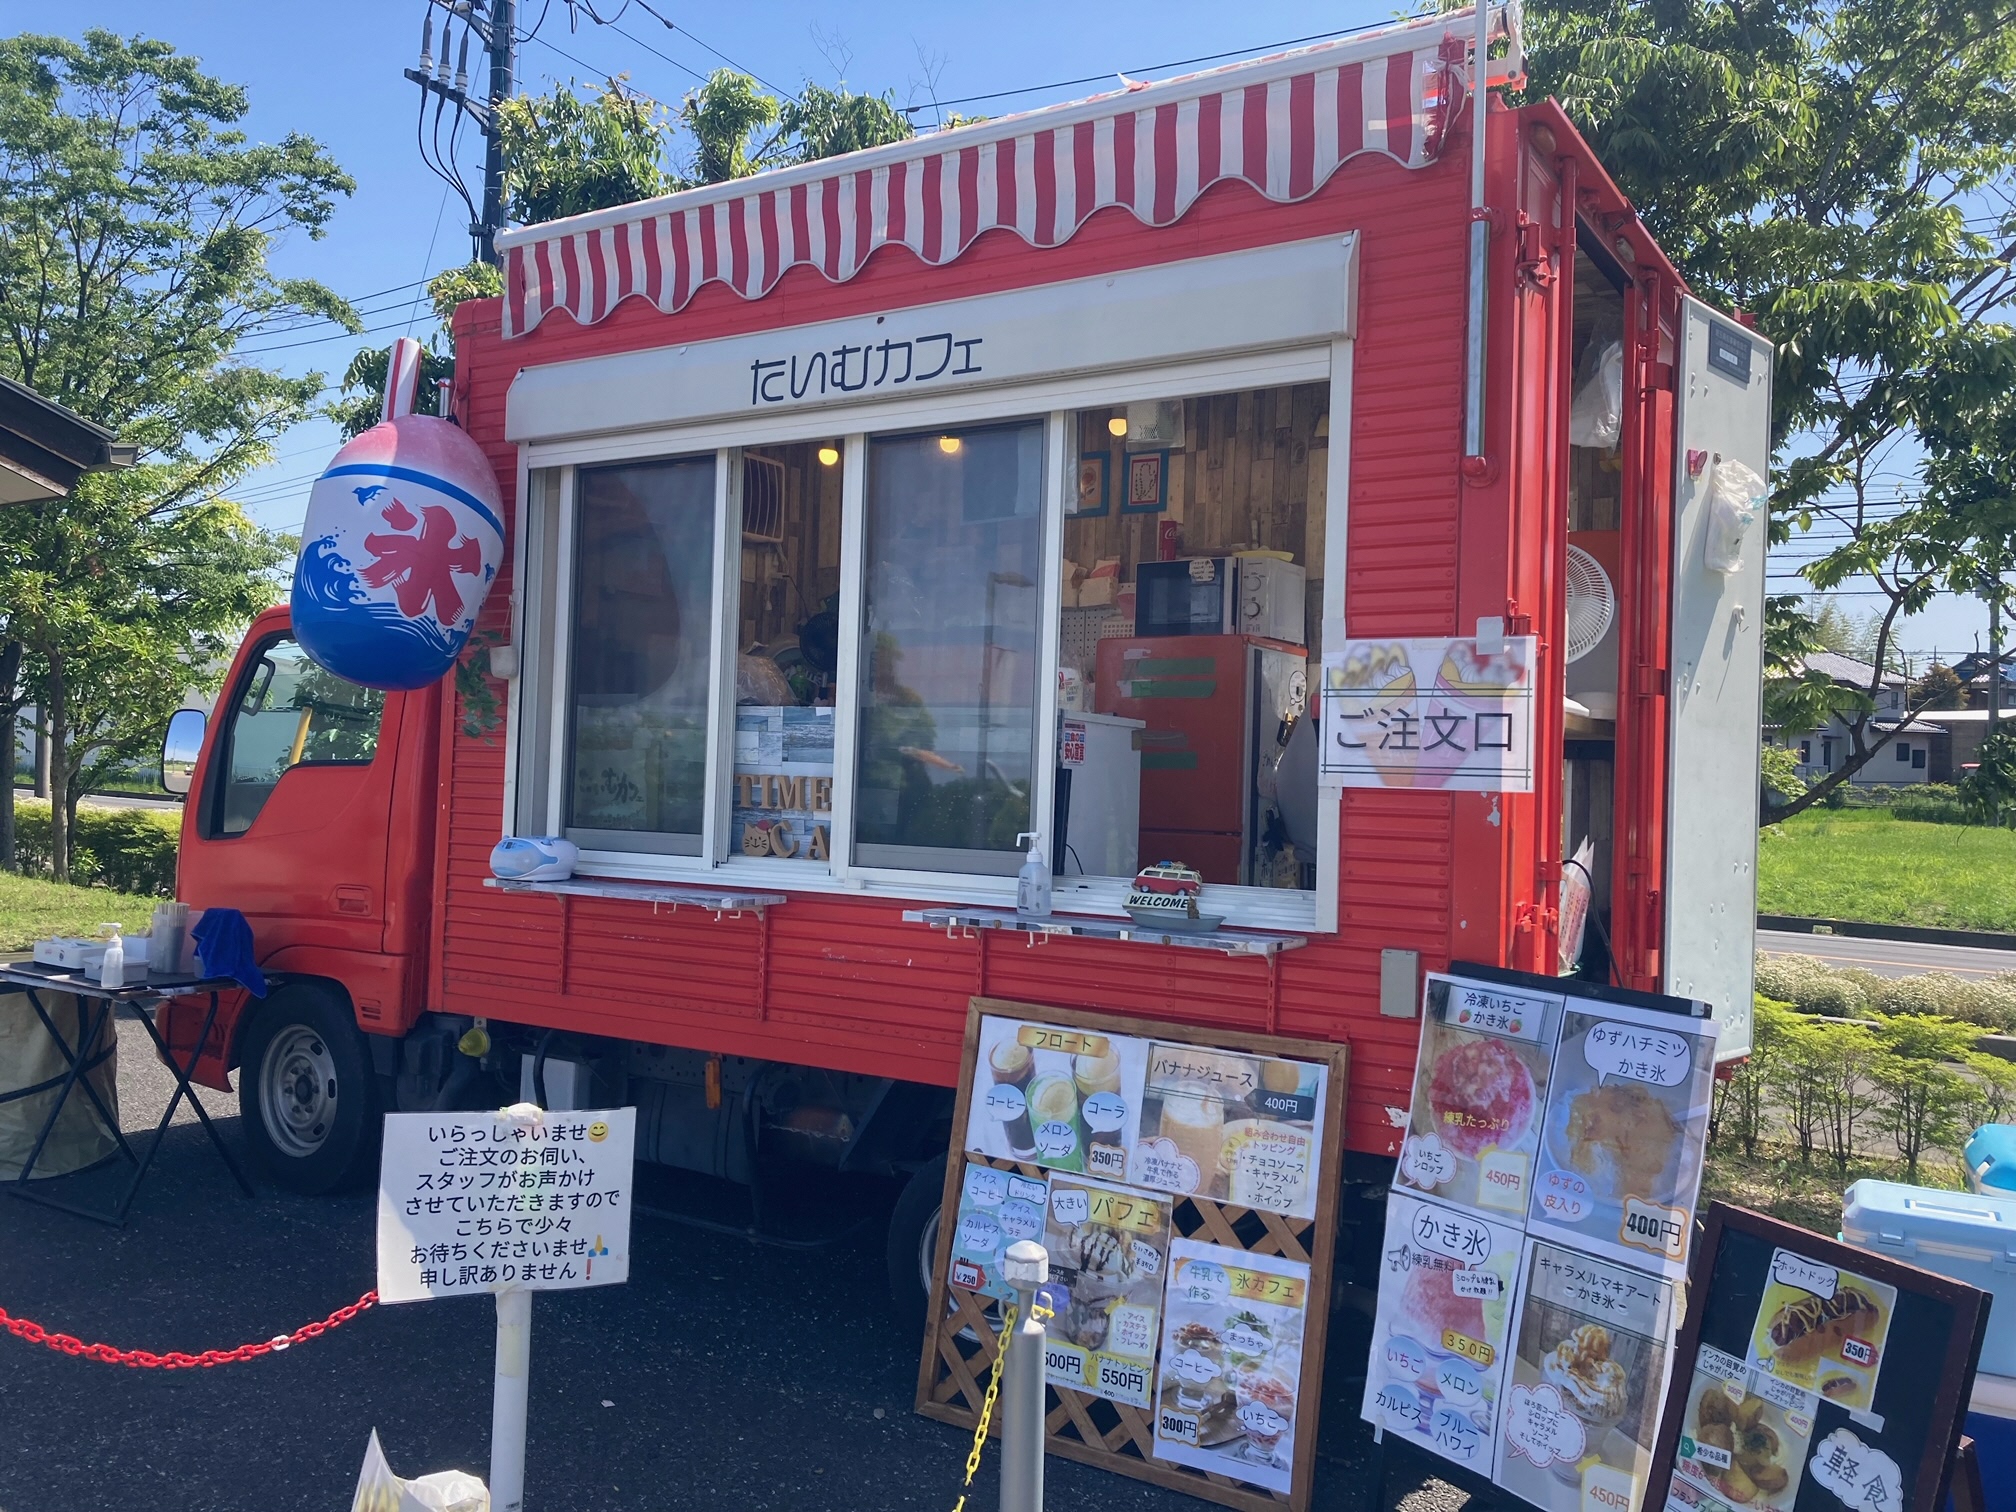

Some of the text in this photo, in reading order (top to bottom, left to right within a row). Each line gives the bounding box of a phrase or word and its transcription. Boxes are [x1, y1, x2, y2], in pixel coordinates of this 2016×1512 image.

[751, 333, 982, 405] たいむカフェ
[1337, 708, 1513, 752] ご注文口
[734, 773, 832, 812] TIME
[1129, 895, 1189, 909] WELCOME
[1464, 992, 1526, 1016] 冷凍いちご
[1473, 1011, 1509, 1030] かき氷
[1036, 1031, 1092, 1051] フロート
[1593, 1027, 1688, 1058] ゆずハチミツ
[1154, 1059, 1253, 1088] バナナジュース
[1618, 1058, 1667, 1083] かき氷
[987, 1095, 1026, 1110] コーヒー
[1088, 1101, 1125, 1119] コーラ
[1264, 1097, 1298, 1113] 400円
[1041, 1123, 1073, 1137] メロン
[1443, 1111, 1510, 1132] 練乳たっぷり
[428, 1124, 588, 1144] いらっしゃいませ
[1244, 1127, 1306, 1147] 組み合わせ自由
[439, 1148, 586, 1167] ご注文のお伺い、
[1039, 1141, 1073, 1157] ソーダ
[1254, 1141, 1296, 1155] トッピング
[1418, 1149, 1442, 1163] いちご
[1092, 1150, 1124, 1169] 350円
[1414, 1160, 1443, 1175] シロップ
[416, 1168, 595, 1191] スタッフがお声かけ
[974, 1171, 997, 1185] アイス
[1256, 1181, 1283, 1195] ソース
[1486, 1169, 1521, 1191] 450円
[1548, 1173, 1585, 1194] ゆずの
[405, 1189, 620, 1216] させていただきますので
[971, 1186, 1003, 1200] コーヒー
[1054, 1197, 1087, 1210] 大きい
[1011, 1202, 1031, 1215] アイス
[1093, 1196, 1155, 1228] パフェ
[1544, 1193, 1581, 1215] 皮入り
[456, 1216, 572, 1236] こちらで少々
[1002, 1213, 1037, 1229] キャラメル
[1627, 1212, 1682, 1247] 400円
[963, 1234, 989, 1248] ソーダ
[1007, 1227, 1021, 1237] ラテ
[1418, 1213, 1488, 1257] かき氷
[410, 1237, 588, 1264] お待ちくださいませ
[1190, 1264, 1225, 1283] 牛乳で
[1540, 1257, 1662, 1306] キャラメルマキアート
[1778, 1260, 1836, 1288] ホットドッグ
[1187, 1285, 1211, 1301] 作る
[1235, 1272, 1295, 1299] 氷カフェ
[1577, 1286, 1615, 1311] かき氷
[1229, 1332, 1264, 1350] まっちゃ
[1447, 1333, 1492, 1363] 350円
[1091, 1353, 1153, 1376] バナナトッピング
[1174, 1358, 1214, 1375] コーヒー
[1386, 1347, 1424, 1375] いちご
[1701, 1348, 1747, 1375] インカの目覚め
[1702, 1359, 1741, 1381] じゃがバター
[1101, 1367, 1144, 1393] 550円
[1440, 1371, 1480, 1396] メロン
[1376, 1390, 1423, 1425] カルピス
[1162, 1415, 1197, 1439] 300円
[1242, 1409, 1279, 1430] いちご
[1439, 1411, 1479, 1437] ブルー
[1527, 1418, 1558, 1436] キャラメル
[1436, 1429, 1475, 1458] ハワイ
[1532, 1428, 1550, 1442] ソース
[1822, 1444, 1889, 1512] 軽食
[1589, 1485, 1630, 1512] 450円
[1673, 1486, 1713, 1512] フランクフ
